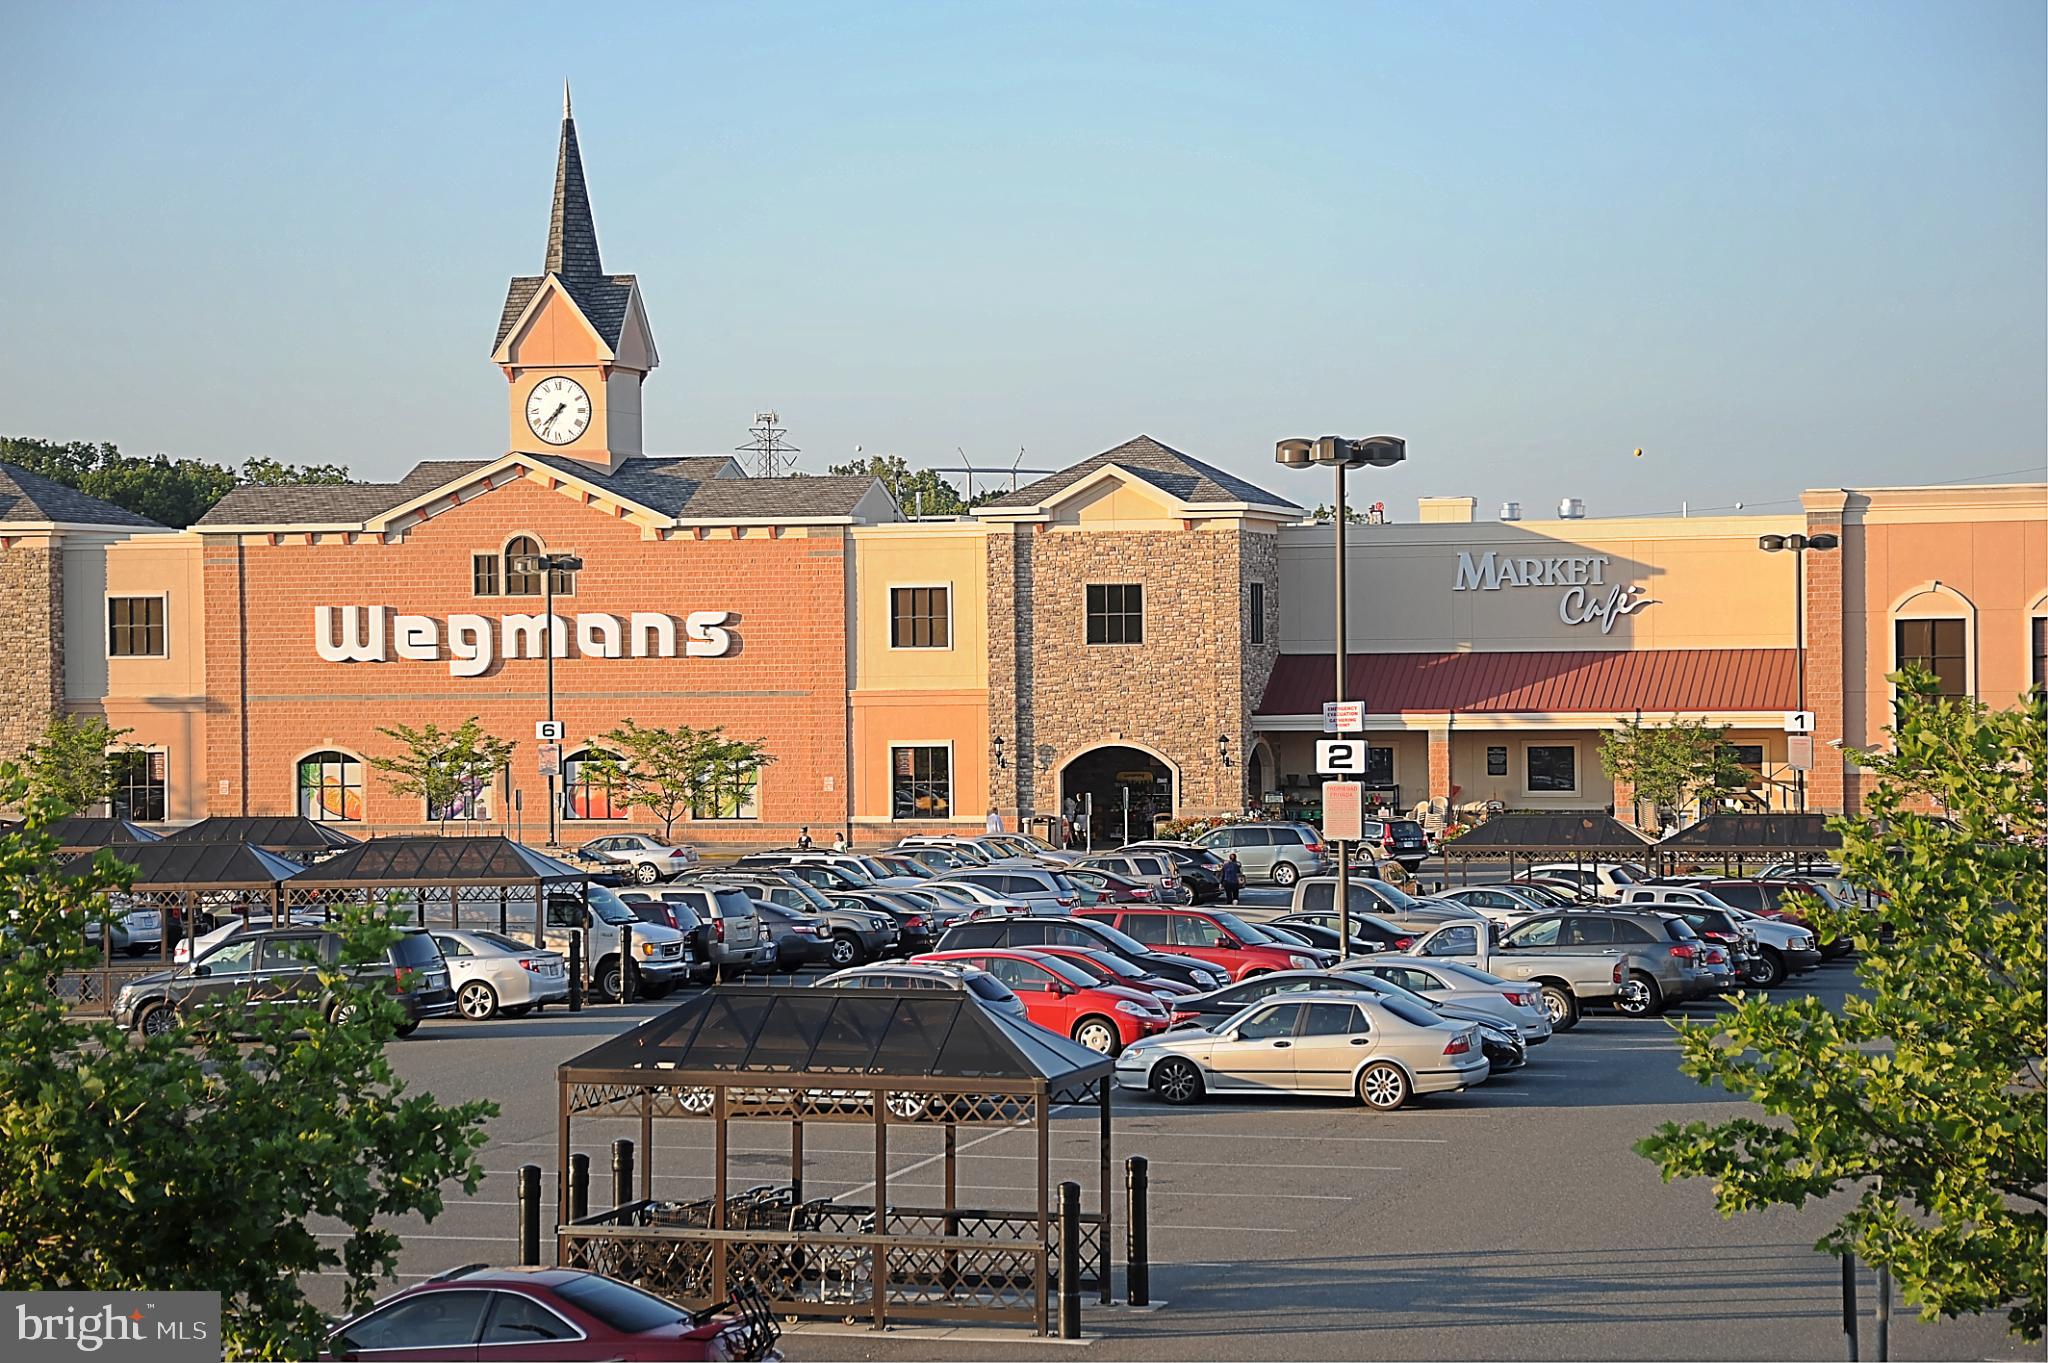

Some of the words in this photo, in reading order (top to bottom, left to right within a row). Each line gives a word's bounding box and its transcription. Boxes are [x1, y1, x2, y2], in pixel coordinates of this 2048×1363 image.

[1453, 552, 1609, 591] MARKET
[315, 605, 731, 677] Wegmans
[542, 723, 555, 737] 6
[1794, 714, 1805, 729] 1
[1328, 744, 1353, 769] 2
